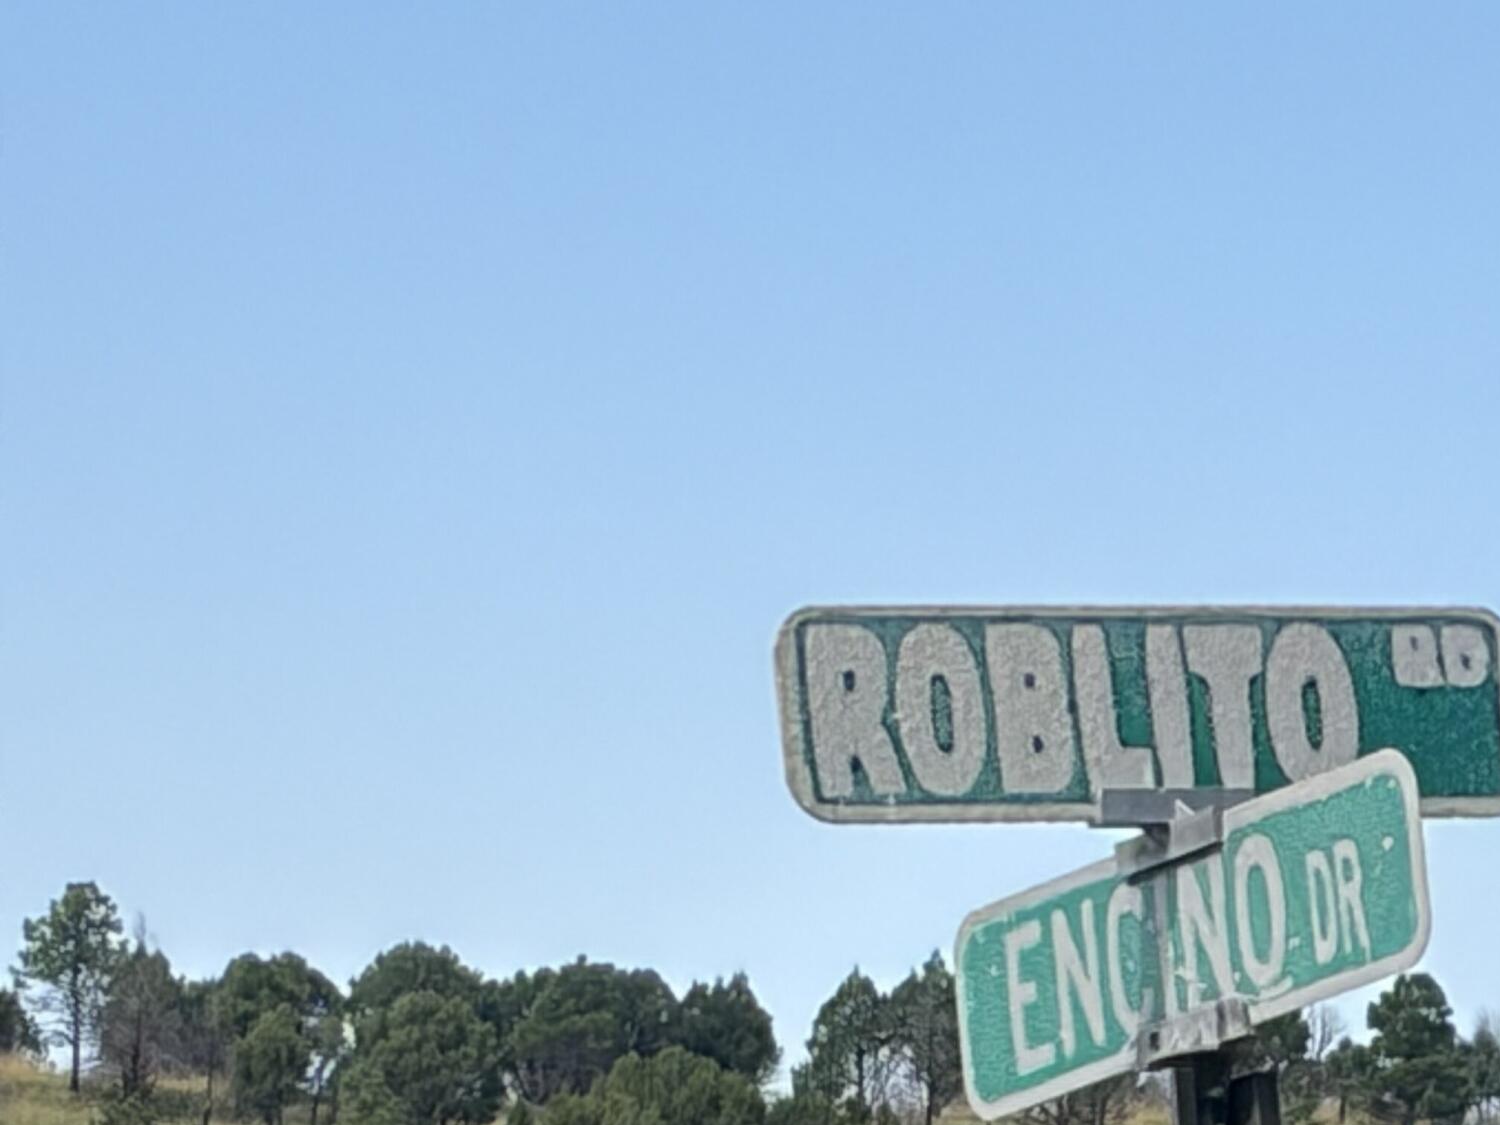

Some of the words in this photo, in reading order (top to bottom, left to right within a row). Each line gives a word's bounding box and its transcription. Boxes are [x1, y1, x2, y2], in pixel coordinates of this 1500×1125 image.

[805, 622, 1360, 797] ROBLITO
[1391, 624, 1490, 688] RD
[1004, 833, 1287, 1076] ENCINO
[1306, 838, 1370, 966] DR
